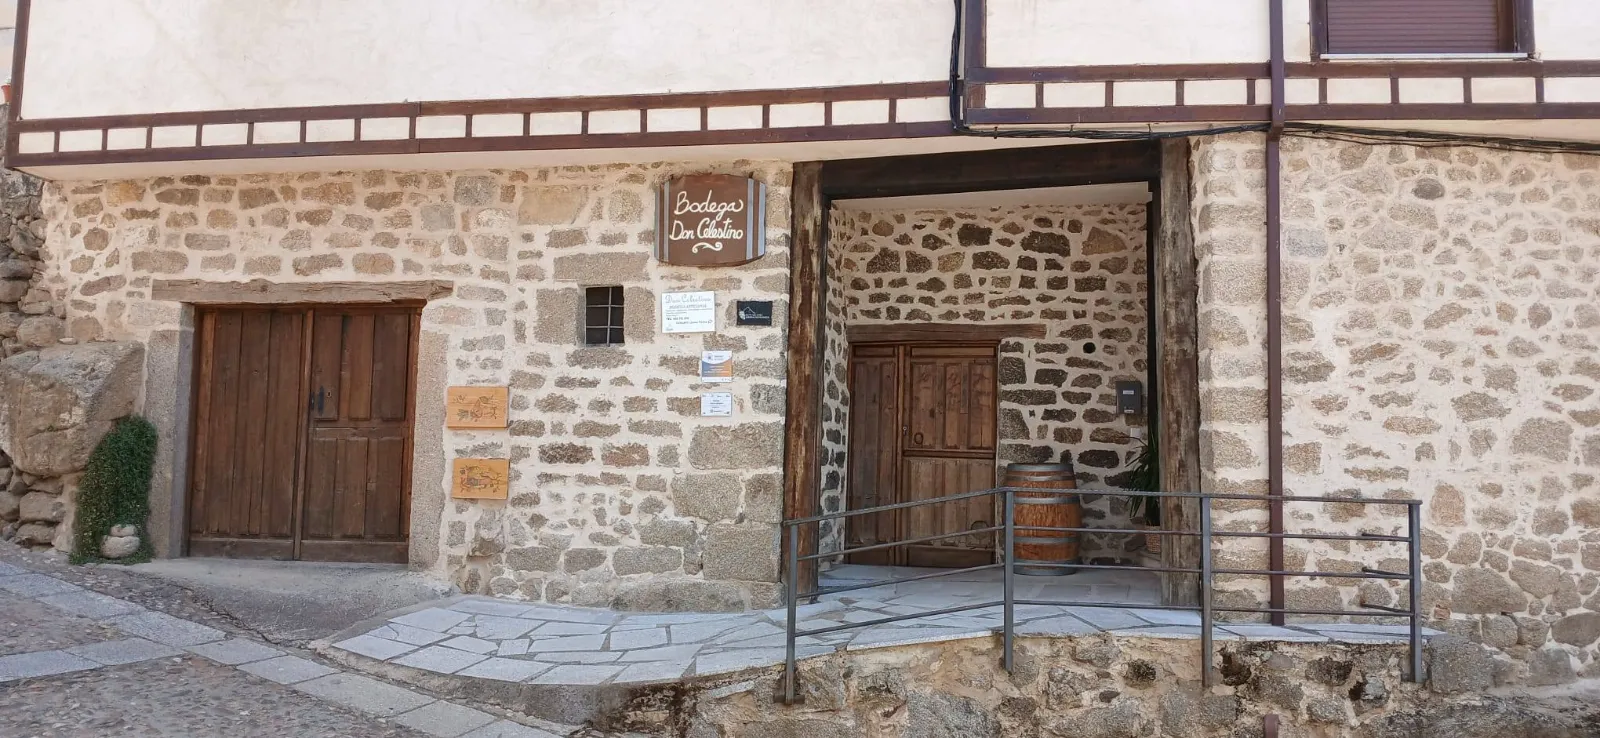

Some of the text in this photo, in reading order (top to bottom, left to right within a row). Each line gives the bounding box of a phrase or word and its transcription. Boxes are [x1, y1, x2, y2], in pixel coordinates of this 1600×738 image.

[673, 189, 744, 221] Bodega
[669, 217, 744, 241] Don Celestino
